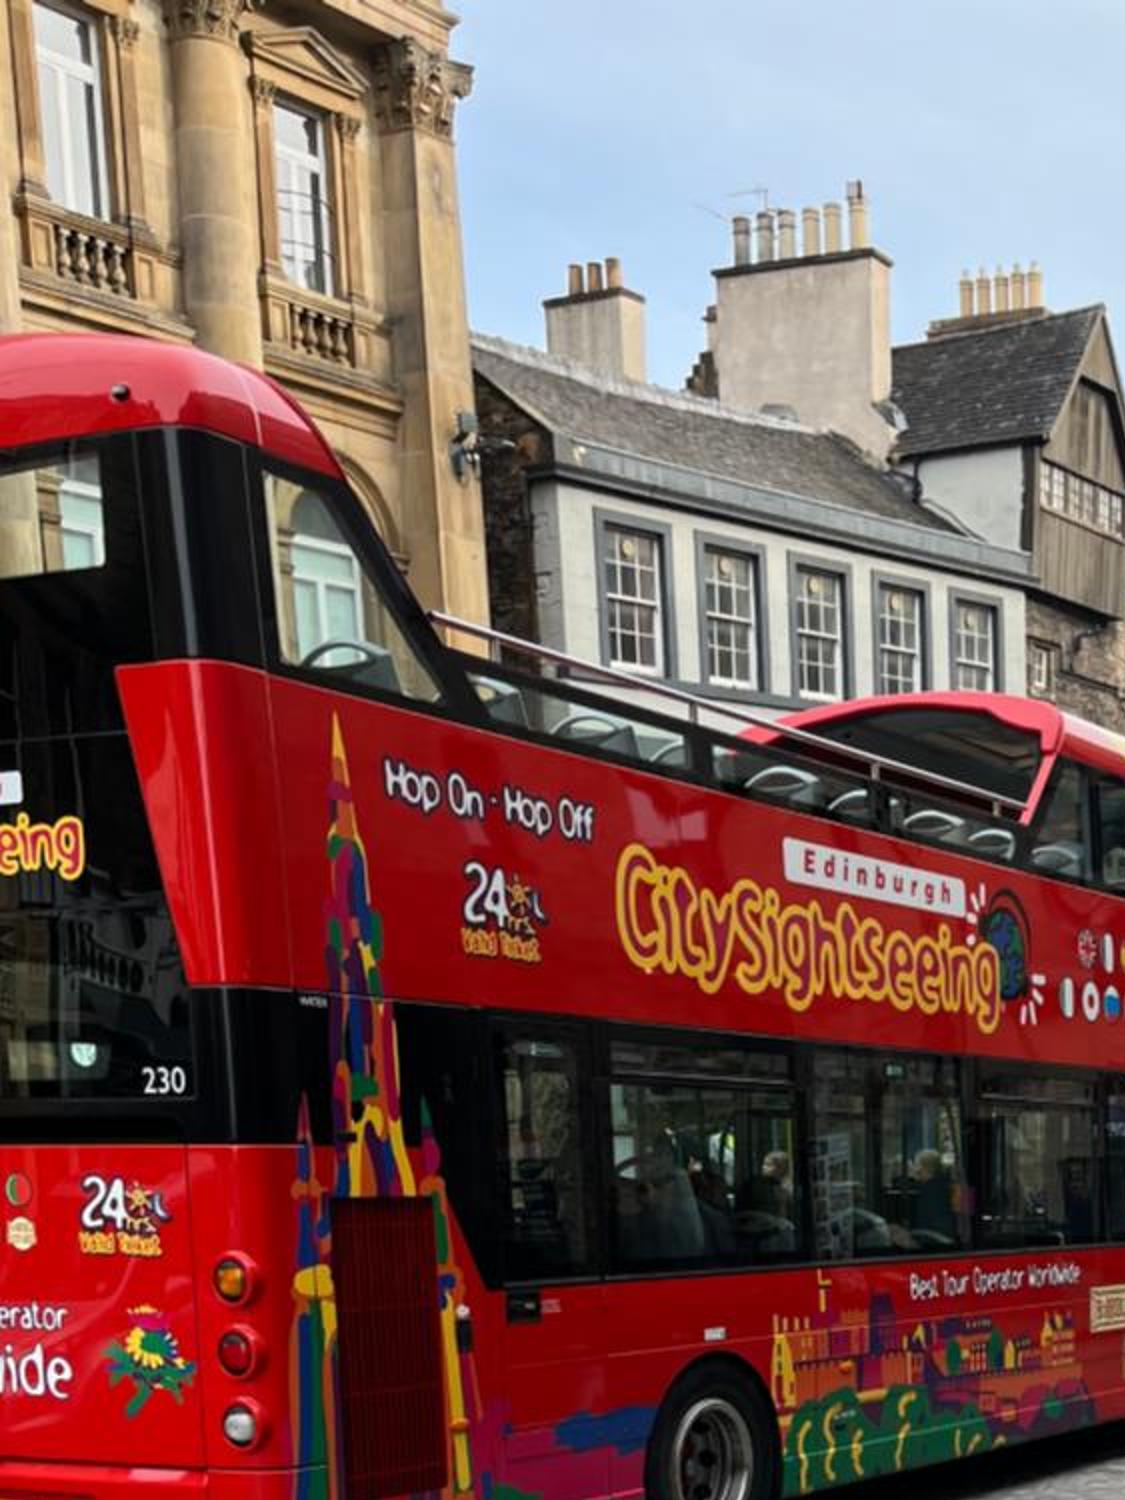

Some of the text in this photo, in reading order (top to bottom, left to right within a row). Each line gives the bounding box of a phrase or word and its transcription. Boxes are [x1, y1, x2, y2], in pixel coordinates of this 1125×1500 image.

[384, 759, 441, 813] Hop
[448, 773, 484, 818] On
[504, 786, 552, 836] Hop
[558, 798, 593, 841] Off
[463, 861, 509, 928] 24
[803, 848, 952, 906] Edinburgh
[615, 842, 1001, 1034] CitySightseeing
[142, 1066, 187, 1094] 230
[80, 1174, 126, 1229] 24
[909, 1272, 939, 1300] Best
[941, 1269, 969, 1296] Tour
[972, 1265, 1025, 1296] Operator
[0, 1343, 73, 1399] ide
